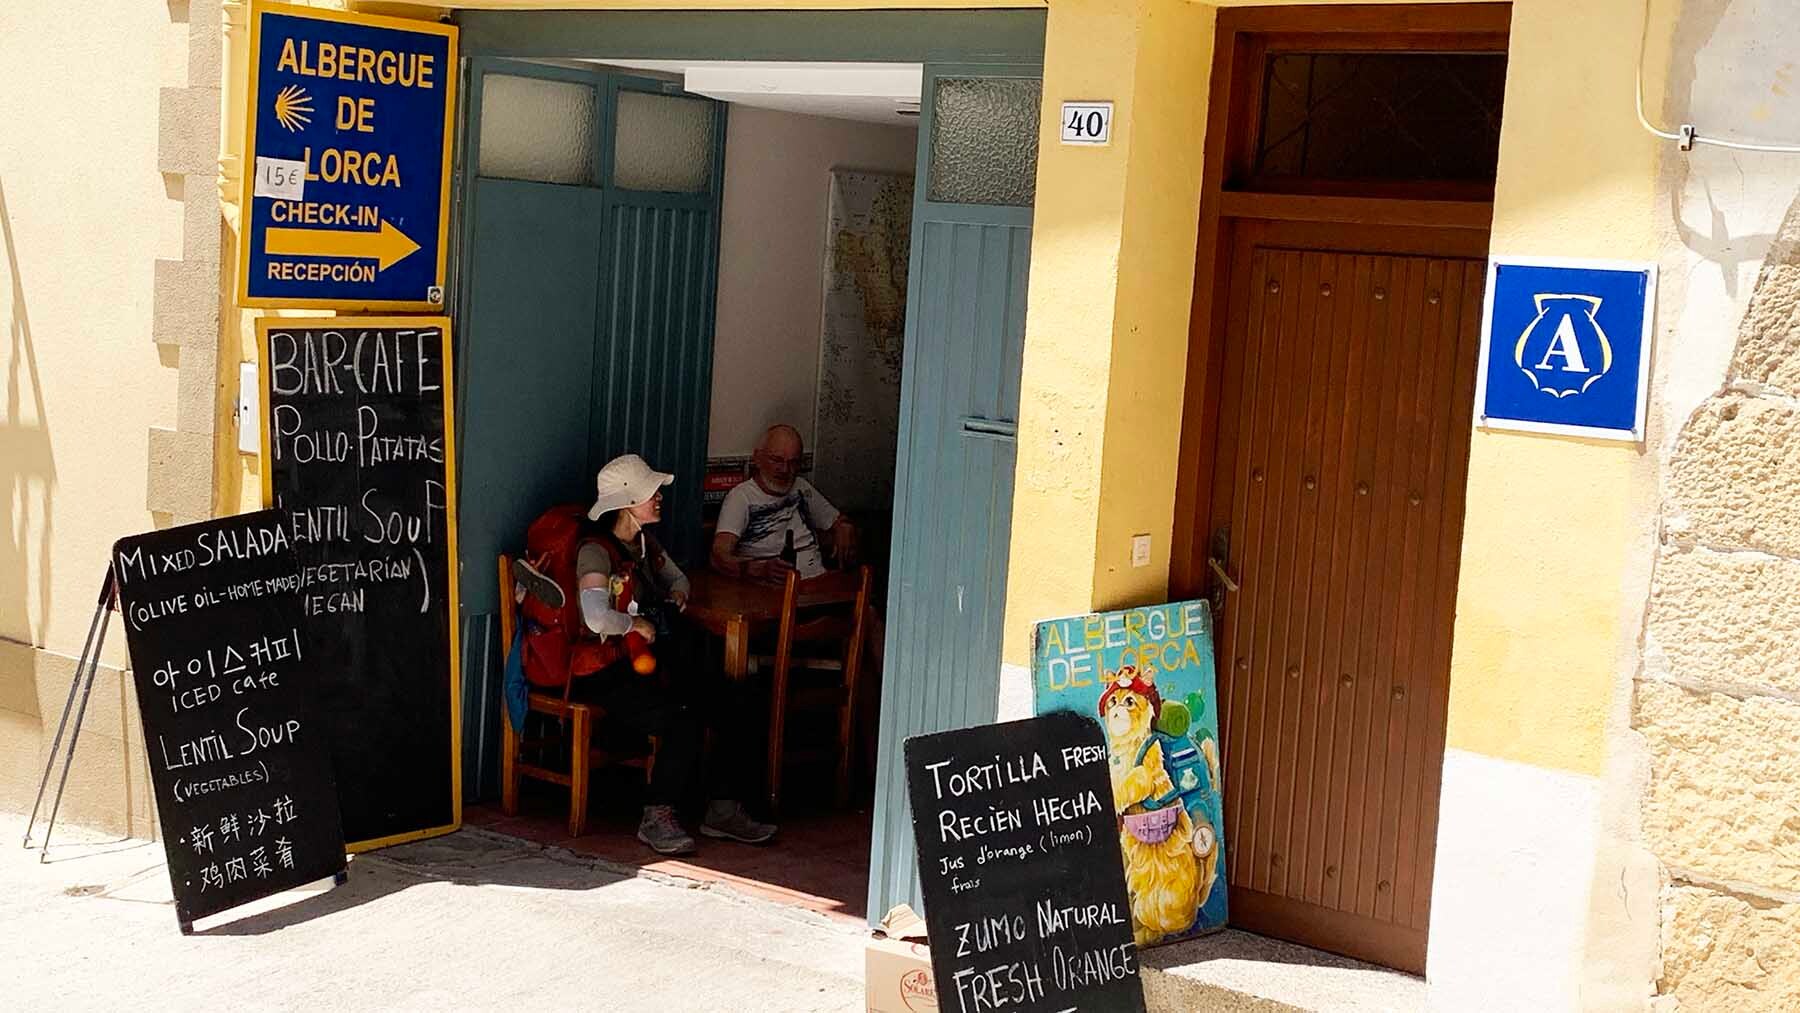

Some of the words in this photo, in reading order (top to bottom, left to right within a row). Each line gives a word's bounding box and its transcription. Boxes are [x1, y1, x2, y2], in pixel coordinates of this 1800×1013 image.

[277, 38, 434, 89] ALBERGUE
[337, 96, 375, 133] DE
[1067, 110, 1103, 137] 40
[266, 165, 299, 187] 15€
[304, 147, 401, 188] LORCA
[271, 200, 379, 227] CHECK-IN
[267, 261, 376, 283] RECEPCIÓN
[270, 331, 440, 396] BAR-CAFE
[1535, 313, 1590, 373] A
[120, 546, 196, 584] MIXED
[197, 523, 289, 567] SALADA
[1044, 604, 1204, 657] ALBERGUE
[1049, 654, 1092, 692] DE
[172, 684, 221, 713] ICED
[159, 730, 234, 770] LENTIL
[236, 707, 301, 756] SOUP
[925, 752, 1050, 800] TORTILLA
[1061, 746, 1107, 771] FRESH
[1032, 790, 1103, 828] HECHA
[954, 914, 1026, 958] ZUMO
[1036, 899, 1126, 938] NATURAL
[952, 961, 1045, 1013] FRESH
